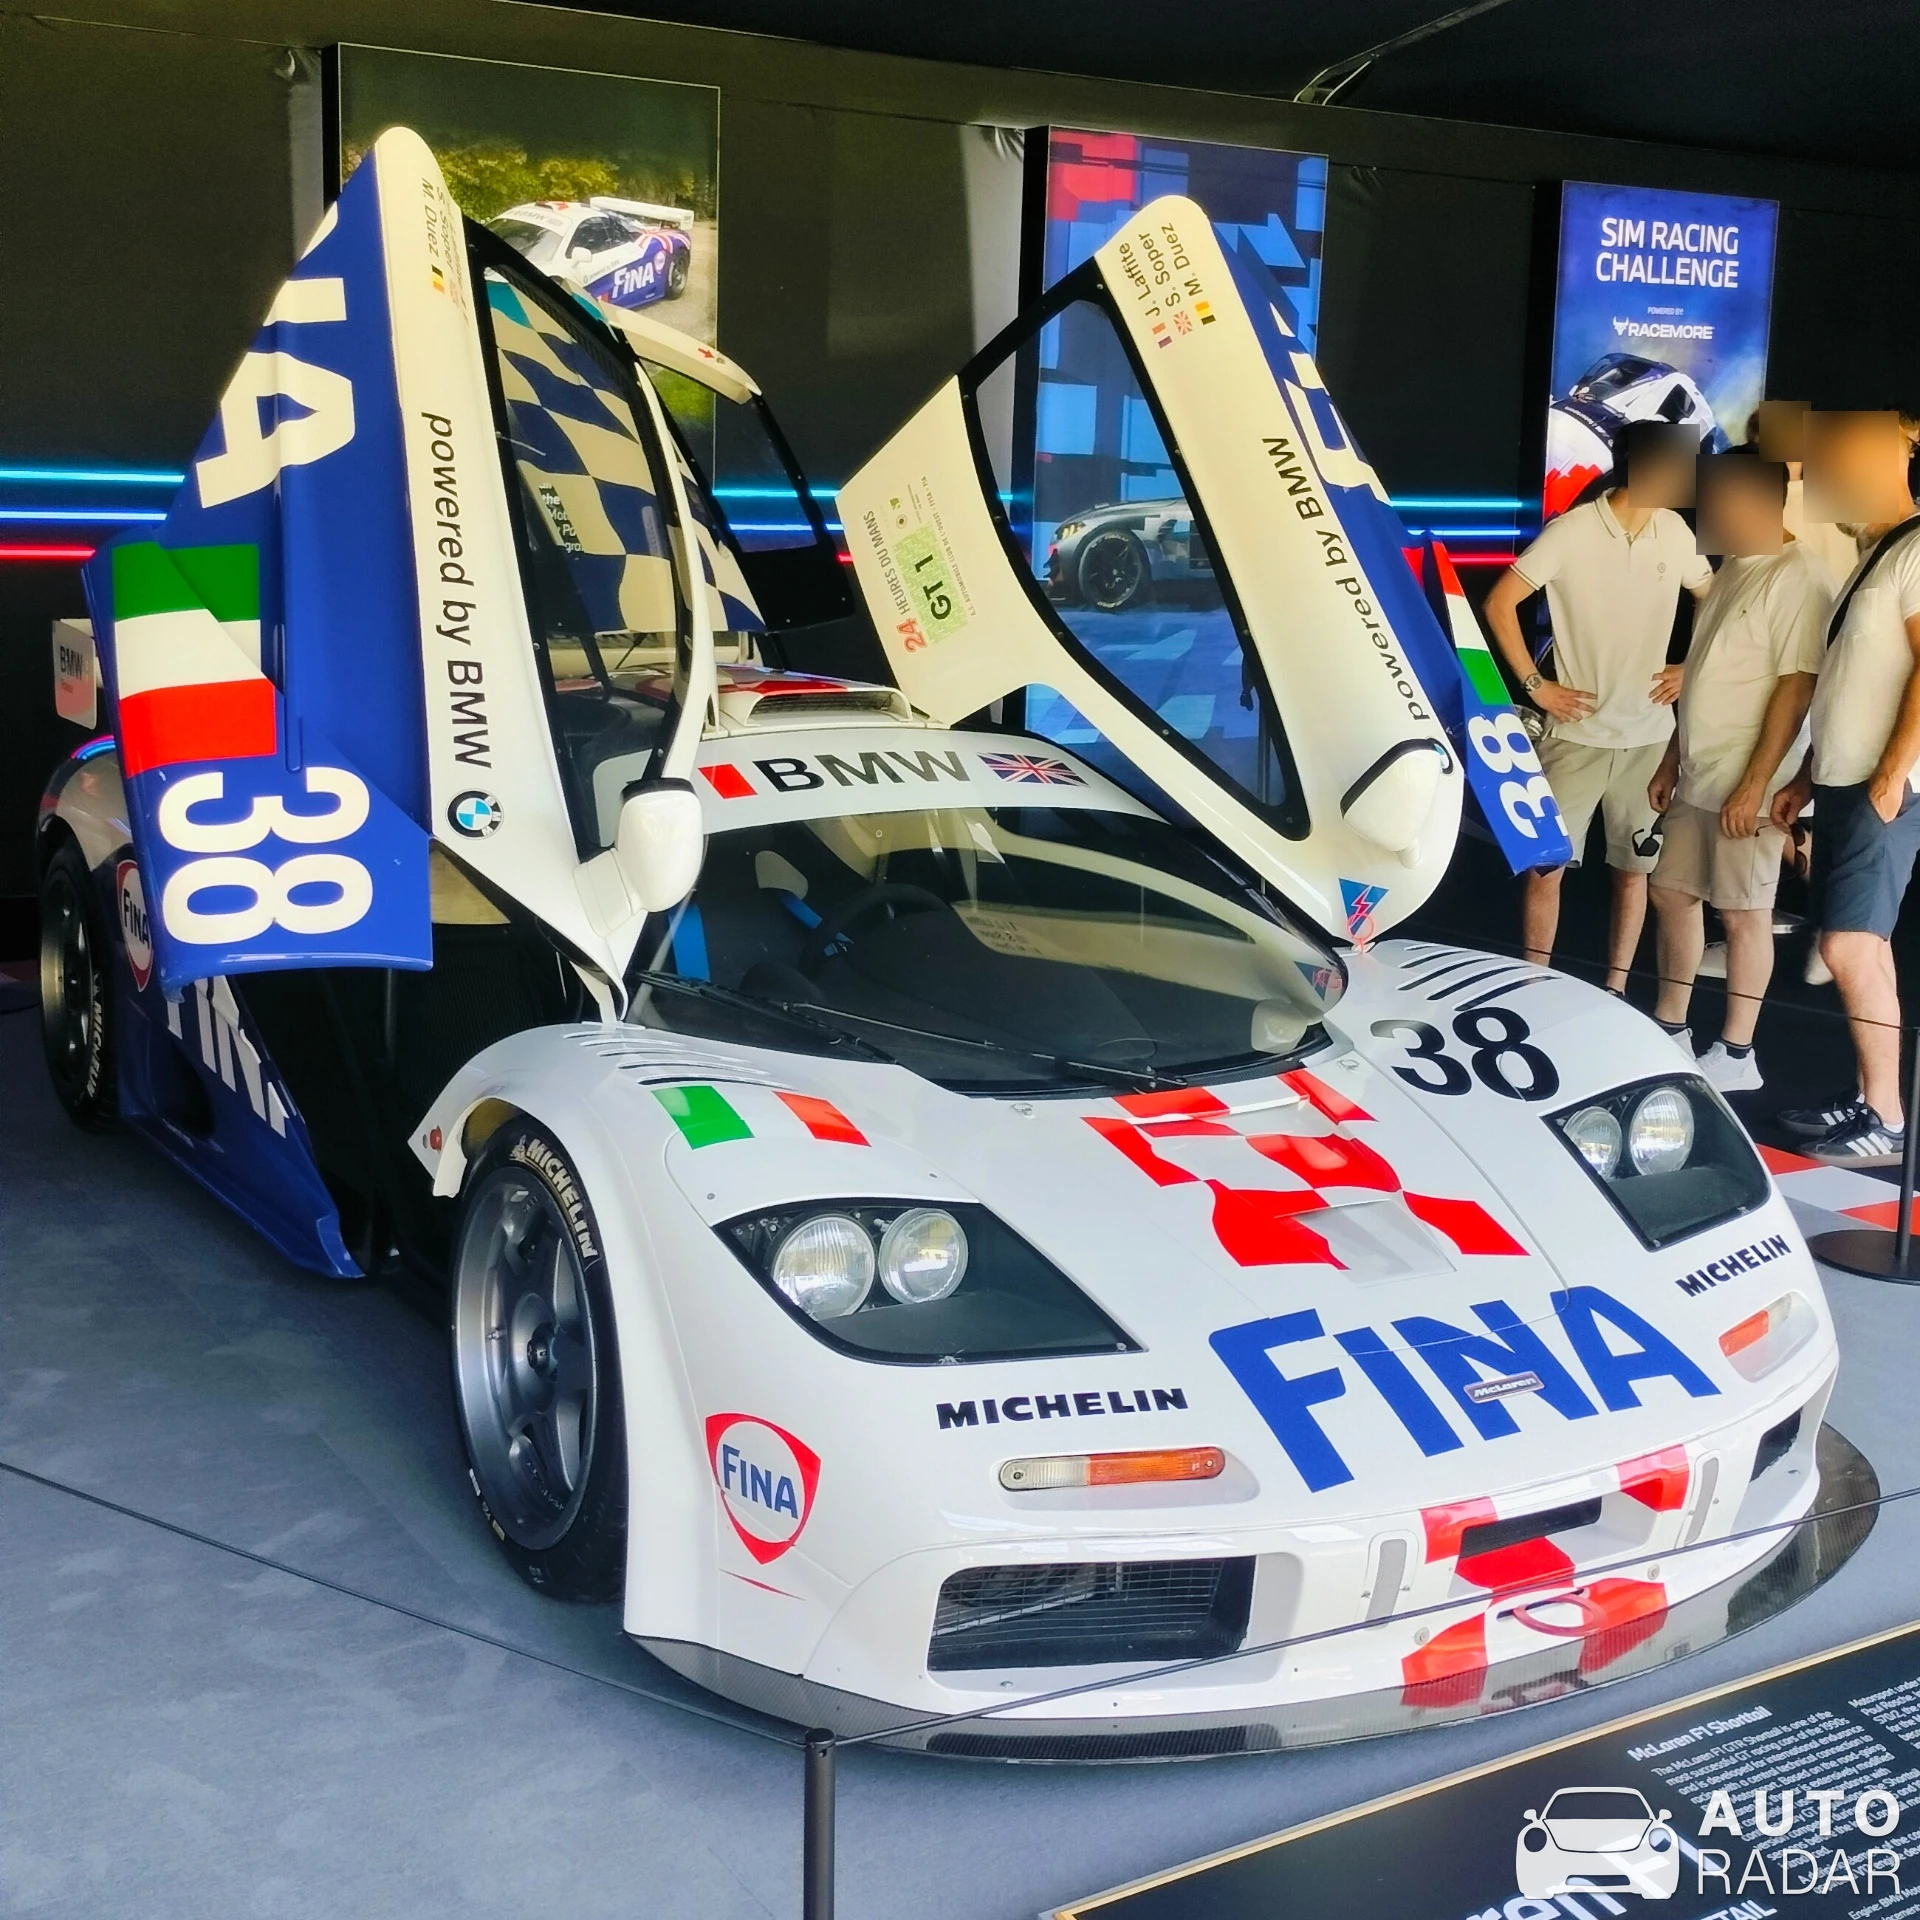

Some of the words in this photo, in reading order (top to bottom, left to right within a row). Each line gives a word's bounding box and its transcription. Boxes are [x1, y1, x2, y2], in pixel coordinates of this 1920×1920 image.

[424, 204, 440, 258] Duez
[1161, 222, 1191, 271] Duez
[1601, 217, 1645, 248] SIM
[1651, 221, 1739, 254] RACING
[1119, 242, 1152, 301] Laffite
[1138, 232, 1171, 286] Soper
[1596, 252, 1739, 288] CHALLENGE
[612, 262, 654, 298] FINA
[1165, 286, 1181, 308] S.
[1183, 272, 1204, 297] M.
[1144, 300, 1161, 317] J.
[1628, 322, 1713, 339] RACEMORE
[1262, 438, 1324, 520] BMW
[421, 412, 475, 587] powered
[863, 510, 885, 547] MANS
[1315, 529, 1348, 567] by
[876, 547, 892, 569] DU
[914, 554, 934, 573] 1
[883, 567, 911, 616] HEURES
[922, 580, 952, 620] GT
[436, 600, 477, 646] by
[896, 617, 927, 653] 24
[60, 645, 83, 680] BMW
[1335, 577, 1430, 721] powered
[447, 660, 492, 769] BMW
[754, 750, 970, 793] BMW
[1467, 712, 1570, 840] 38
[157, 767, 374, 946] 38
[123, 888, 150, 950] FINA
[1370, 1006, 1560, 1102] 38
[526, 1138, 598, 1259] MICHELIN
[1675, 1233, 1792, 1297] MICHELIN
[1210, 1283, 1720, 1491] FINA
[1474, 1377, 1537, 1397] McLaren
[936, 1387, 1189, 1430] MICHELIN
[722, 1443, 798, 1519] FINA
[1849, 1688, 1897, 1708] Motorsport
[1894, 1681, 1920, 1693] under
[1862, 1705, 1884, 1716] Paul
[1880, 1696, 1916, 1709] Rosche.
[1900, 1706, 1919, 1715] the
[1627, 1735, 1696, 1761] McLaren
[1688, 1726, 1714, 1740] F1
[1706, 1706, 1773, 1734] Shorttail
[1650, 1766, 1675, 1777] The
[1670, 1753, 1715, 1770] McLaren
[1709, 1747, 1726, 1756] F1
[1721, 1740, 1747, 1752] GTR
[1741, 1727, 1783, 1745] Shorttail
[1789, 1720, 1809, 1729] one
[1806, 1715, 1819, 1723] of
[1814, 1711, 1834, 1720] the
[1886, 1725, 1902, 1733] for
[1898, 1720, 1917, 1728] the
[1665, 1773, 1692, 1786] most
[1689, 1756, 1739, 1777] successful
[1734, 1751, 1753, 1761] GT
[1750, 1743, 1782, 1756] racing
[1777, 1736, 1800, 1747] cars
[1796, 1732, 1809, 1740] of
[1804, 1727, 1824, 1736] the
[1819, 1718, 1851, 1731] 1990s
[1677, 1784, 1700, 1795] and
[1704, 1764, 1755, 1785] developed
[1750, 1761, 1767, 1769] for
[1763, 1740, 1821, 1764] international
[1817, 1726, 1865, 1745] endurance
[1746, 1768, 1780, 1784] central
[1775, 1754, 1818, 1773] technical
[1815, 1739, 1864, 1759] connection
[1859, 1735, 1874, 1743] to
[1778, 1770, 1811, 1785] Based
[1808, 1766, 1824, 1775] on
[1819, 1761, 1839, 1770] the
[1836, 1744, 1887, 1764] road-going
[1798, 1784, 1812, 1792] is
[1809, 1767, 1860, 1788] extensively
[1855, 1752, 1895, 1771] modified
[1868, 1766, 1892, 1779] with
[1896, 1784, 1917, 1796] and
[1801, 1808, 1820, 1818] GT
[1832, 1824, 1854, 1834] the
[1889, 1837, 1910, 1847] the
[1878, 1894, 1905, 1907] BMW
